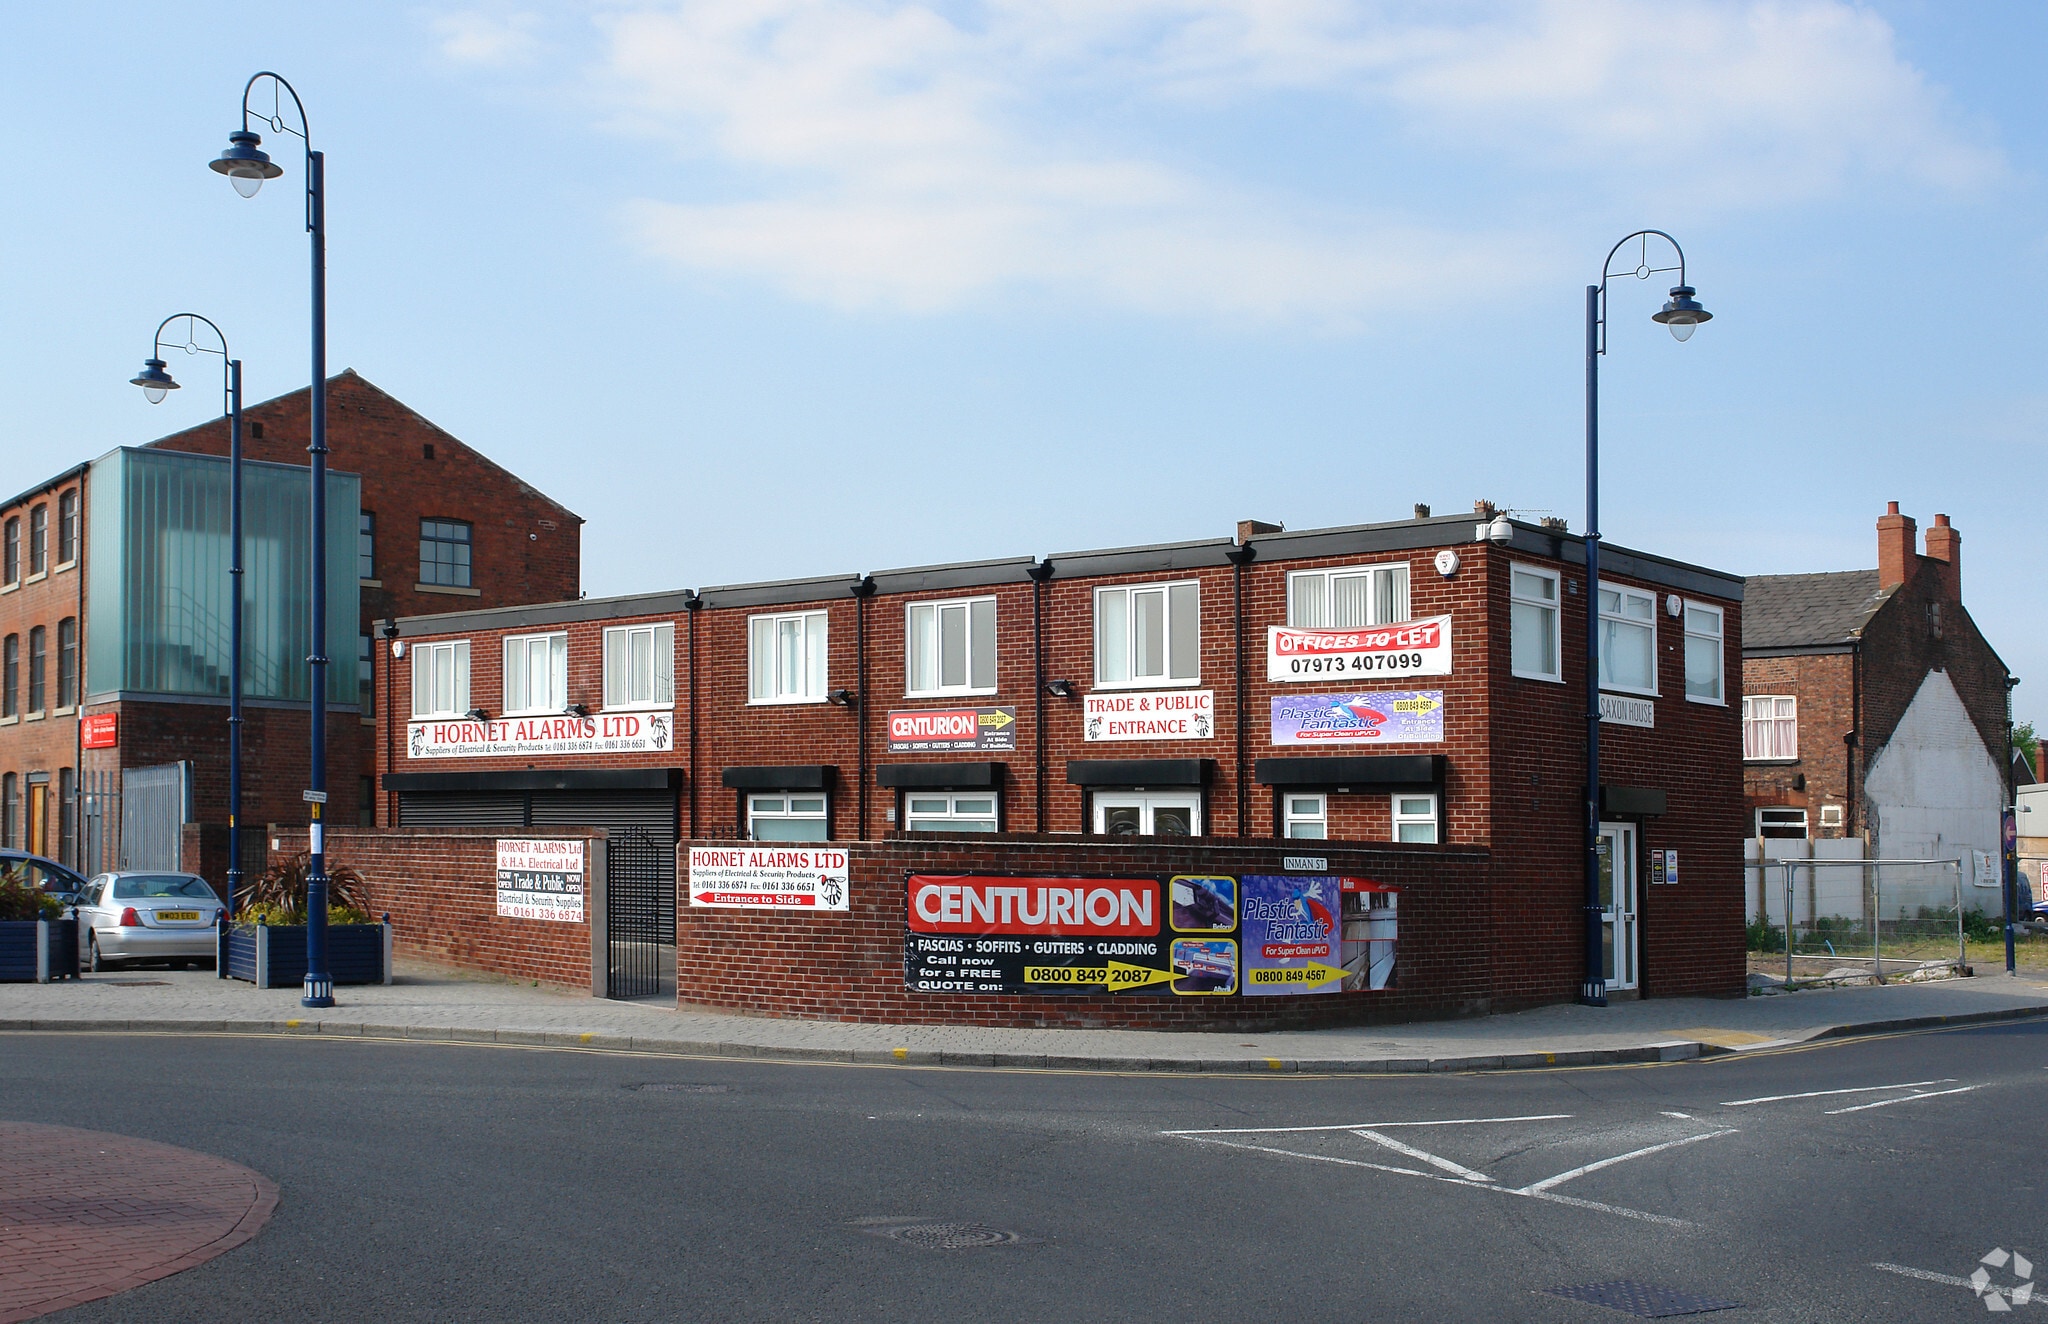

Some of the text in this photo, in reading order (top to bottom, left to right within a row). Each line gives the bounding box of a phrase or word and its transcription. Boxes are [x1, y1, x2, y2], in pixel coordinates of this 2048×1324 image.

[1279, 627, 1437, 651] OFFICES TO LET
[1291, 653, 1422, 673] 07973 407099
[1088, 694, 1210, 712] TRADE & PUBLIC
[1279, 708, 1332, 720] Plastic
[1600, 697, 1652, 724] SAXON HOUSE
[434, 716, 640, 744] HORNET ALARMS LTD
[892, 715, 974, 736] CENTURION
[1109, 719, 1188, 734] ENTRANCE
[1301, 716, 1378, 730] Fantastic
[425, 745, 451, 756] Suppliers
[452, 744, 459, 755] of
[458, 744, 485, 754] Electrical
[486, 744, 491, 752] &
[493, 743, 516, 753] Security
[517, 742, 543, 751] Products
[553, 742, 566, 751] 0161
[567, 741, 577, 750] 336
[604, 740, 618, 749] 0161
[619, 740, 630, 749] 336
[631, 739, 646, 748] 6651
[932, 741, 951, 749] GUTTERS
[953, 740, 977, 748] CLADDING
[498, 841, 582, 854] HORNET ALARMS Ltd
[501, 856, 578, 870] & H.A. Electrical Ltd
[693, 852, 845, 868] HORNET ALARMS LTD
[1286, 859, 1315, 869] INMAN
[499, 871, 511, 879] NOW
[566, 874, 581, 883] NOW
[692, 869, 717, 877] Suppliers
[718, 869, 724, 877] of
[725, 869, 751, 877] Electrical
[760, 870, 785, 879] Security
[498, 880, 512, 888] OPEN
[513, 873, 564, 891] Trade & Public
[566, 884, 582, 893] OPEN
[702, 881, 716, 889] 0161
[718, 881, 730, 889] 336
[731, 881, 747, 889] 6874
[762, 882, 779, 890] 0161
[796, 883, 815, 891] 6651
[499, 892, 581, 909] Electrical & Security Supplies
[714, 893, 801, 905] Entrance to Side
[915, 884, 1152, 927] CENTURION
[180, 911, 197, 920] EEU
[498, 905, 582, 921] Tel: 0161 336 6874
[1244, 897, 1295, 920] Plastic
[1266, 918, 1328, 940] Fantastic
[918, 939, 1157, 955] FASCIAS SOFFITS GUTTERS CLADDING
[1266, 947, 1277, 955] For
[1277, 947, 1295, 957] Super
[1296, 946, 1311, 955] Clean
[927, 955, 995, 966] Call now
[919, 967, 941, 977] for
[960, 969, 1001, 978] FREE
[1031, 968, 1152, 983] 0800 849 2087
[1256, 969, 1326, 982] 0800 849 4567
[918, 980, 1003, 991] QUOTE on:
